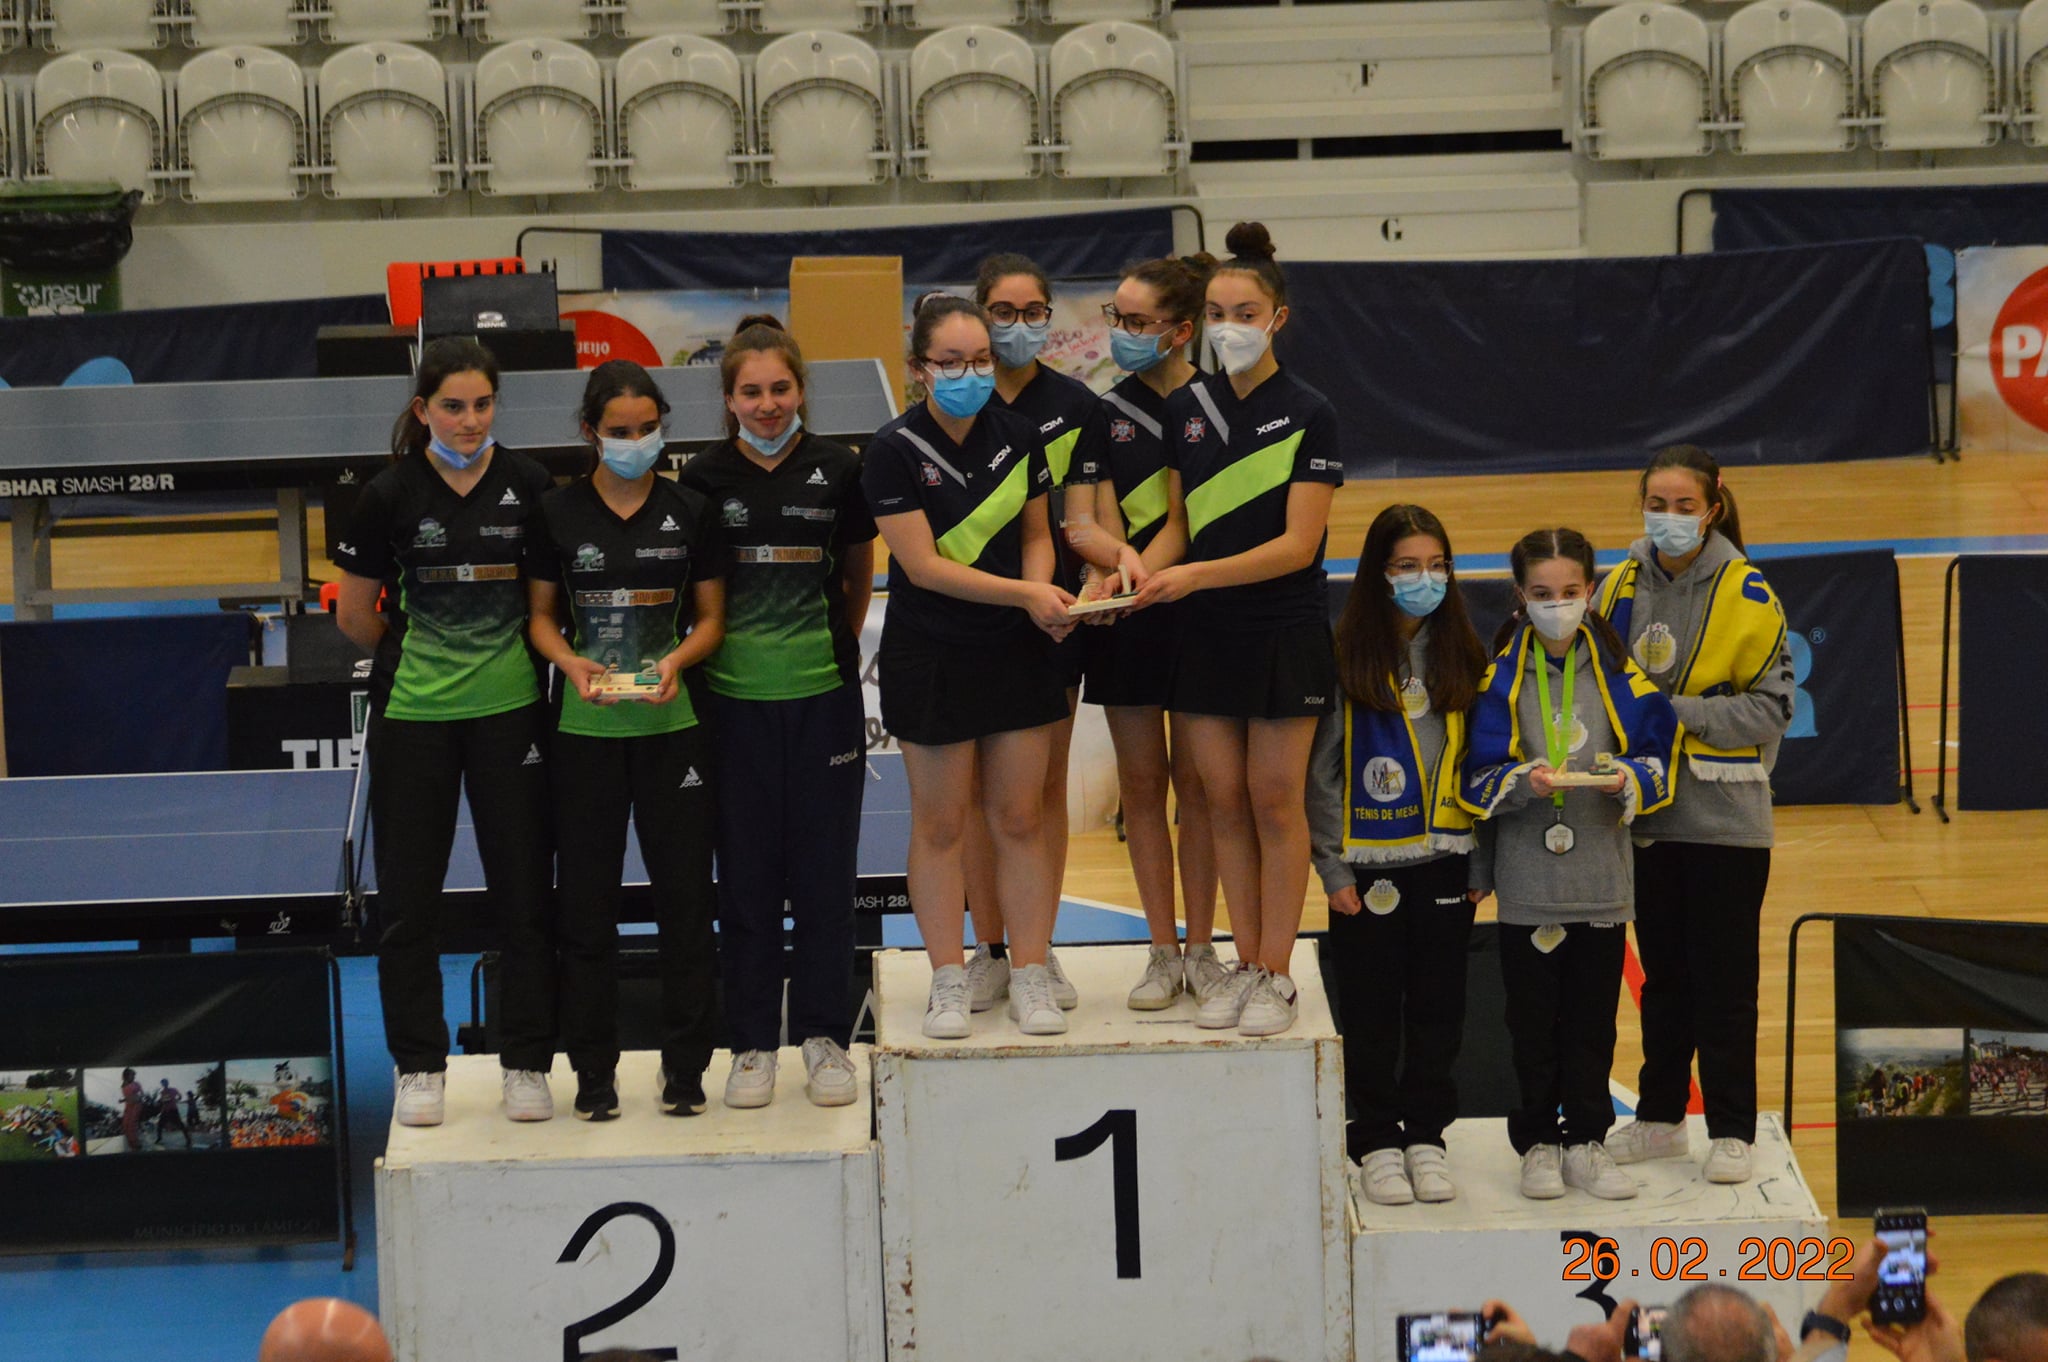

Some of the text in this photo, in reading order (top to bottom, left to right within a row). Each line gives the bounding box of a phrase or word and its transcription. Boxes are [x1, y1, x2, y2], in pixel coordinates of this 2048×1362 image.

[1381, 218, 1402, 242] G
[1256, 416, 1291, 435] XIOM
[988, 445, 1012, 471] XIOM
[62, 476, 125, 495] SMASH
[129, 473, 175, 491] 28/R
[1381, 808, 1393, 820] DE
[1396, 804, 1419, 819] MESA
[1055, 1108, 1142, 1280] 1
[555, 1201, 678, 1362] 2
